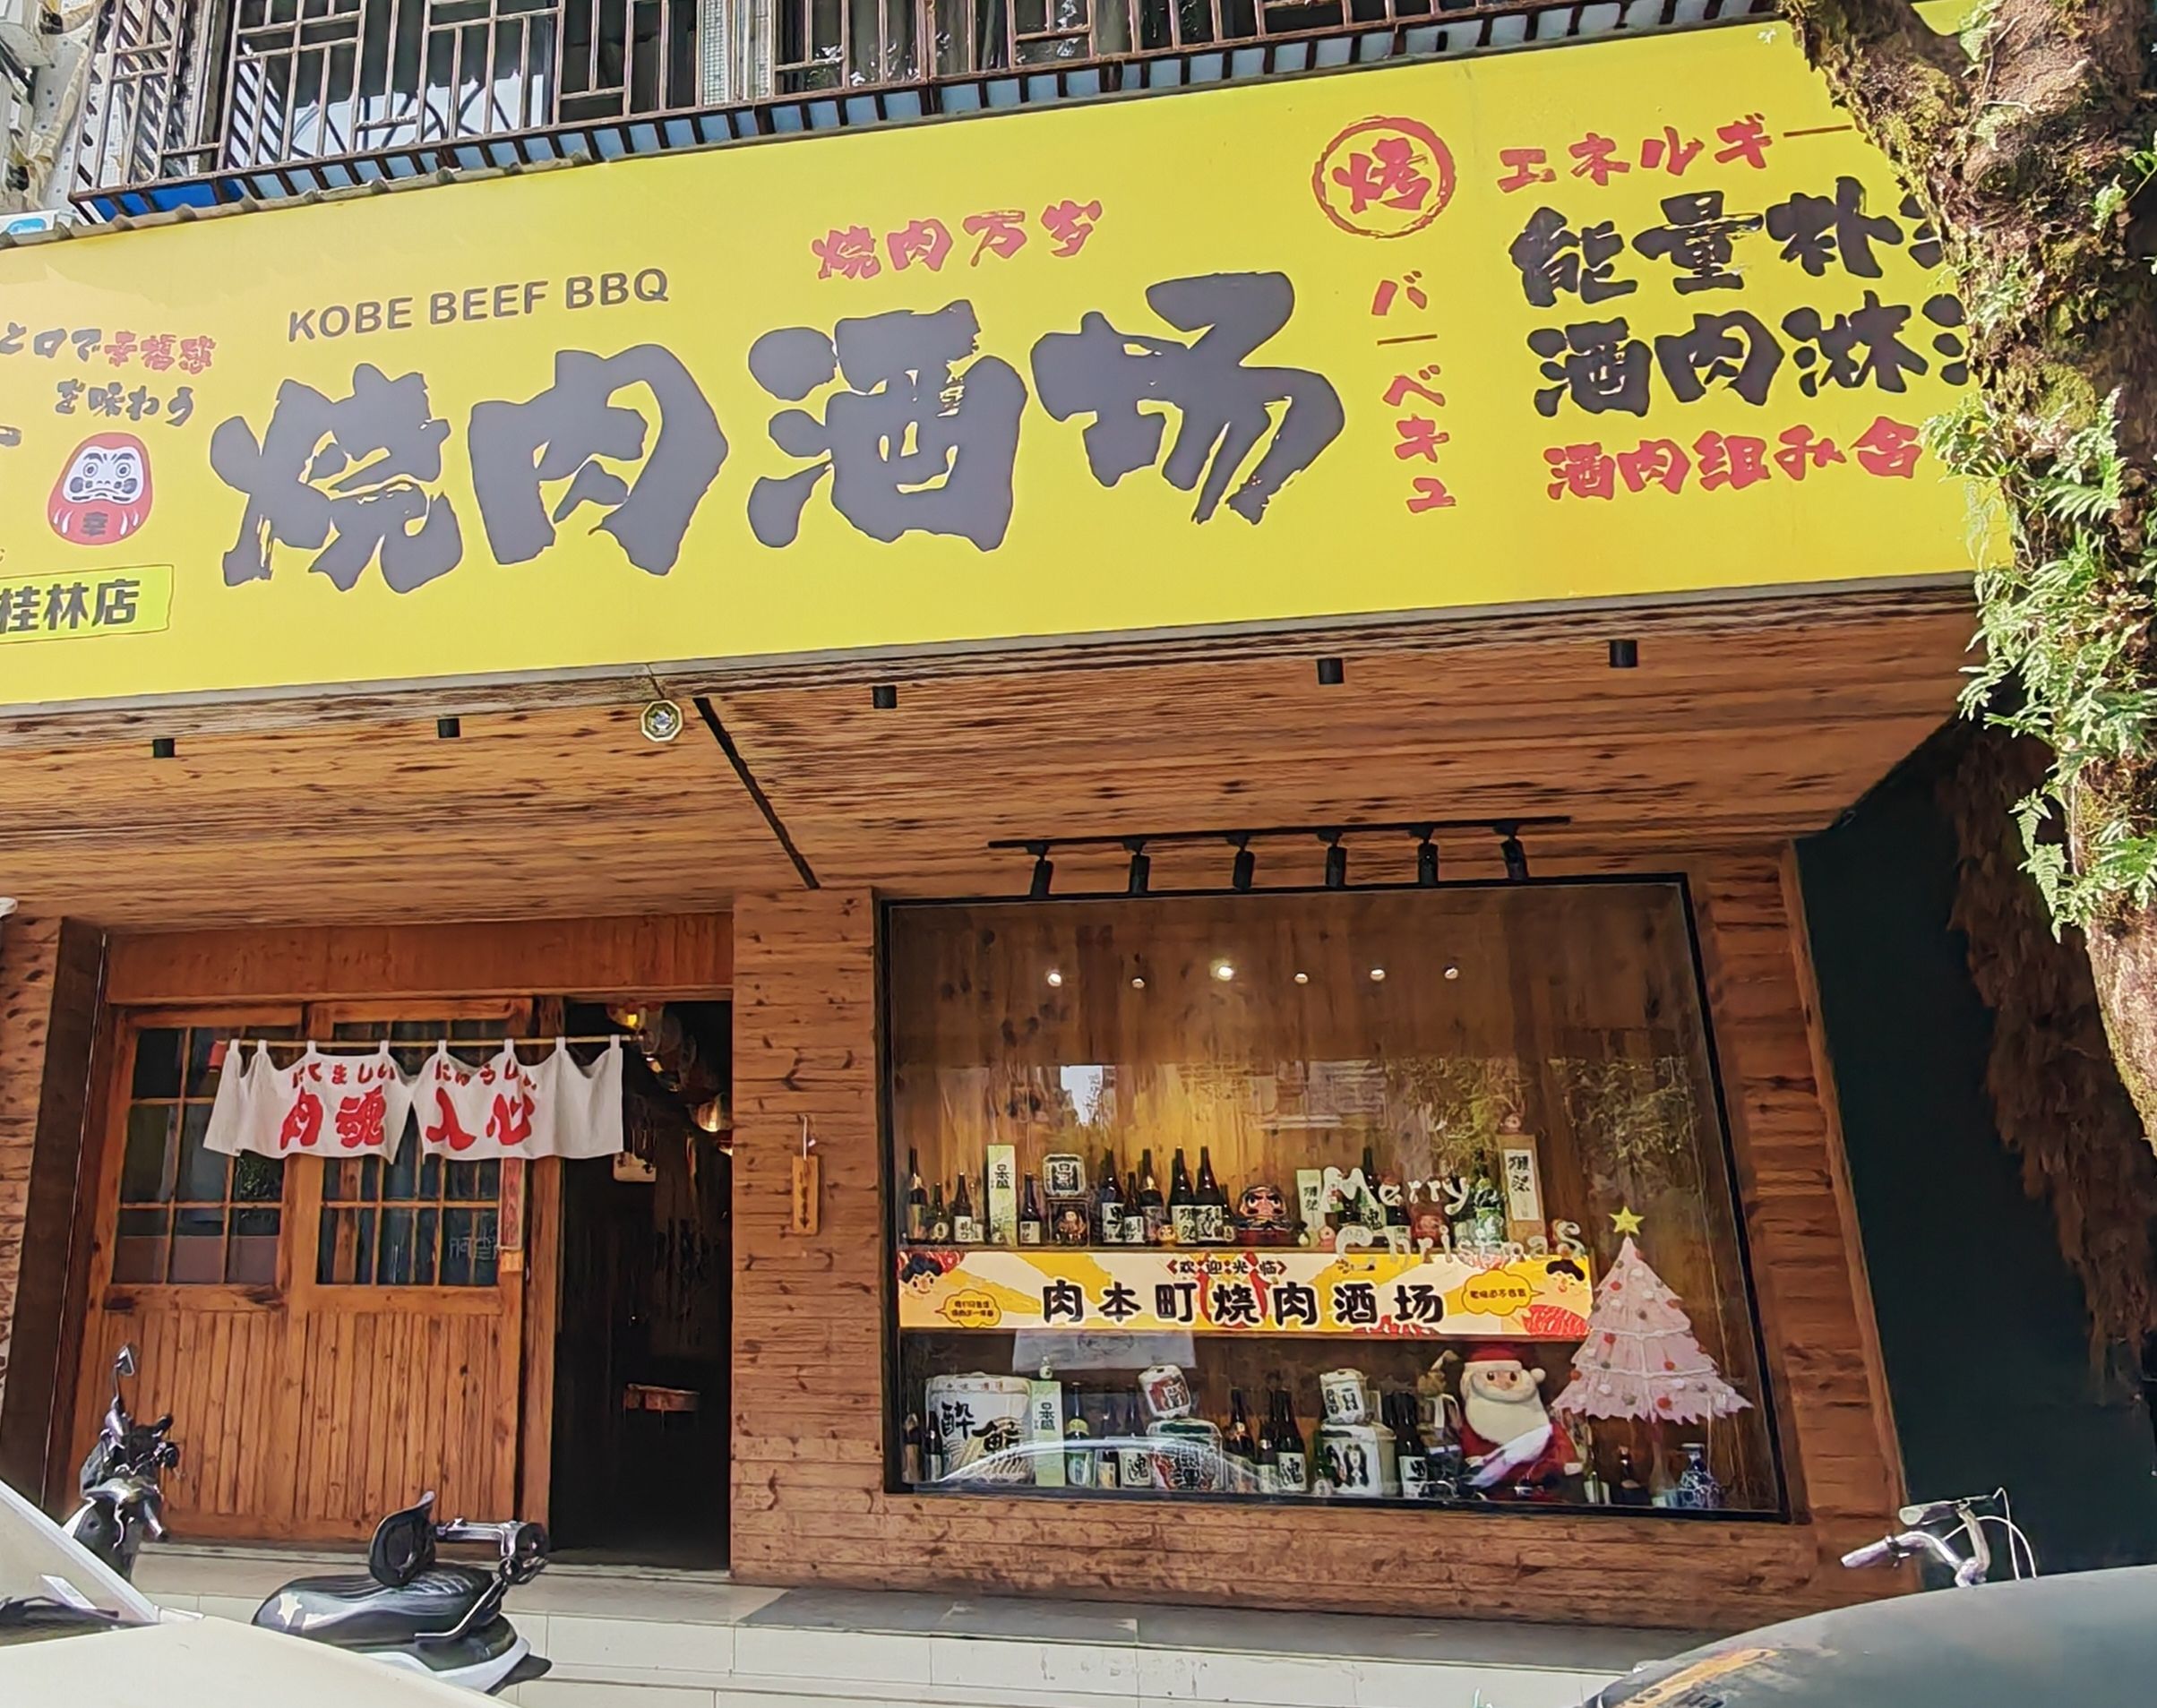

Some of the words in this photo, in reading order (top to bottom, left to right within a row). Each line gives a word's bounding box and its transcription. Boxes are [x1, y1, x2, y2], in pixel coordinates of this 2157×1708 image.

[1509, 176, 1944, 306] 能量补
[289, 297, 412, 341] KOBE
[431, 281, 548, 324] BEEF
[566, 268, 668, 309] BBQ
[1527, 290, 1967, 417] 酒肉淋
[56, 379, 193, 426] を味わう
[0, 579, 140, 634] 桂林店
[1320, 1165, 1471, 1216] Merry
[1180, 1259, 1276, 1276] 欢迎光临
[1043, 1279, 1444, 1326] 肉本町烧肉酒场
